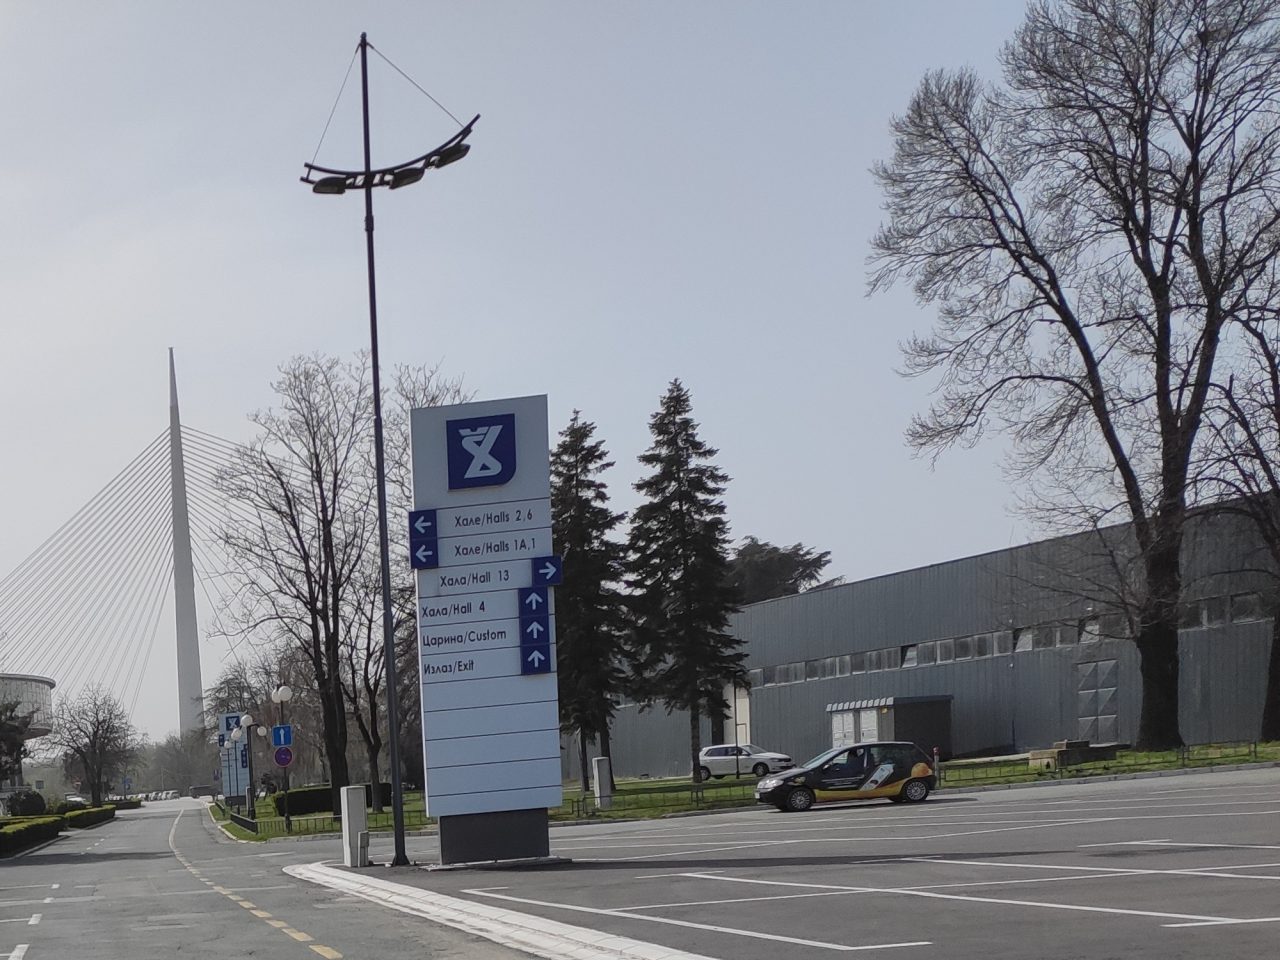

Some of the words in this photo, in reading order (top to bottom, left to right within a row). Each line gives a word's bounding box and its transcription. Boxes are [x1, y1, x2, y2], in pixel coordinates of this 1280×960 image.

[454, 510, 510, 528] Хале/Halls
[454, 540, 510, 557] Хале/Halls
[440, 571, 491, 588] Хала/Hall
[498, 570, 510, 582] 13
[422, 602, 472, 618] Хала/Hall
[479, 601, 486, 613] 4
[422, 630, 507, 649] Царина/Custom
[423, 659, 475, 676] Излаз/Exit
